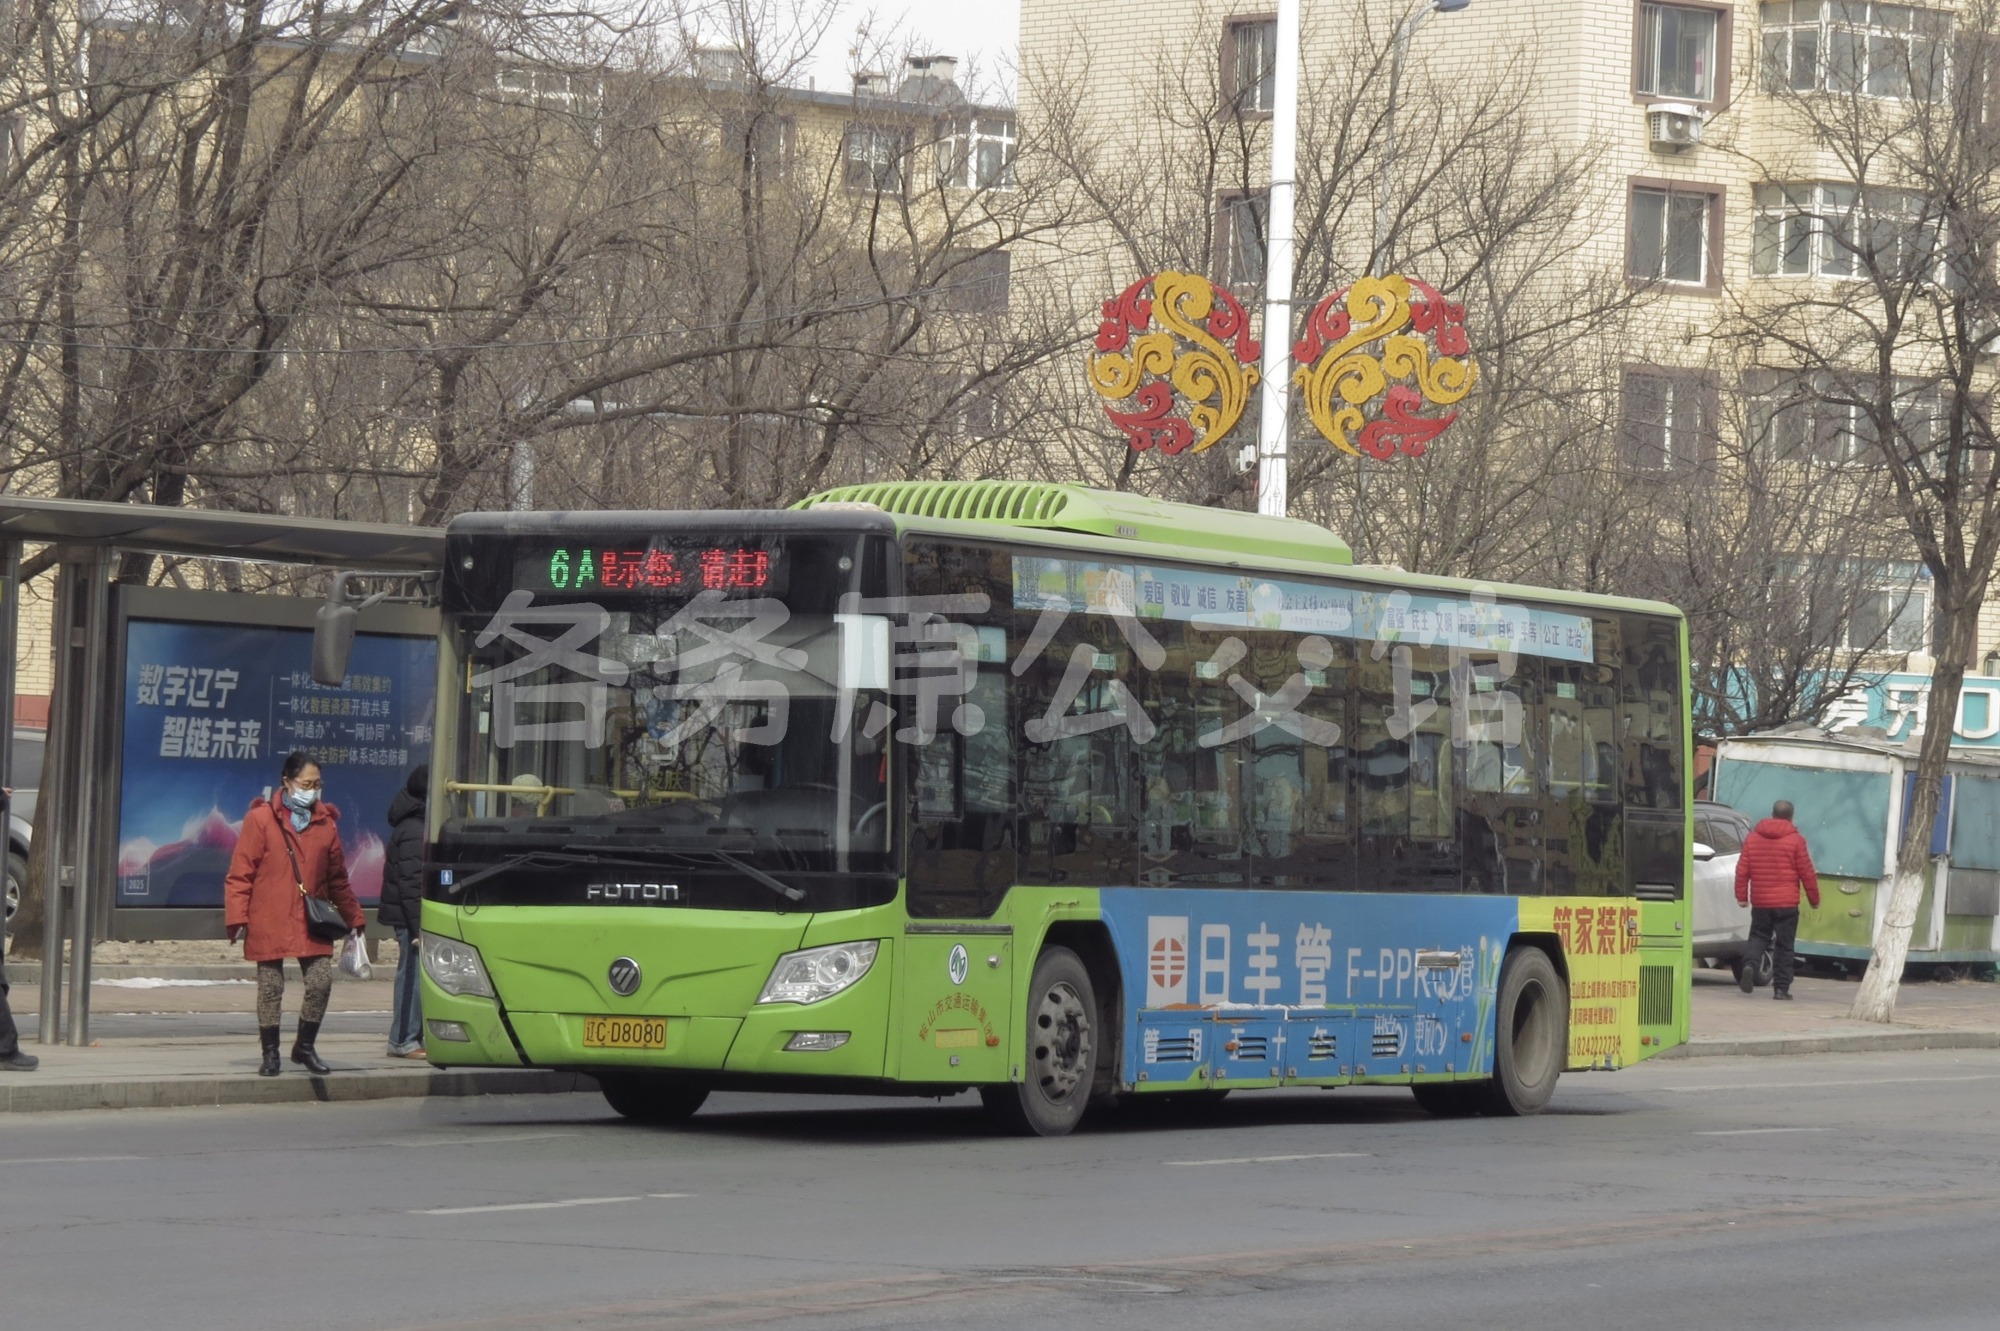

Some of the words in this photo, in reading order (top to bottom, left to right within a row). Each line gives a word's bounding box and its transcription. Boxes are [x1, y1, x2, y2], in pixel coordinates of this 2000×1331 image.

[550, 549, 595, 588] 6A
[1144, 580, 1164, 604] 爱国
[1171, 583, 1191, 607] 敬业
[1197, 586, 1217, 610] 诚信
[1226, 589, 1247, 613] 友善
[1386, 606, 1406, 630] 富强
[1411, 608, 1430, 632] 民主
[1435, 611, 1453, 634] 文明
[1521, 621, 1537, 643] 平等
[1543, 624, 1560, 646] 公正
[1565, 626, 1583, 649] 法治
[136, 664, 240, 709] 数字辽宁
[280, 671, 392, 694] 一体化施高效集约
[279, 696, 391, 718] 一体化数据资源开放共享
[160, 715, 262, 760] 智链未来
[128, 879, 145, 890] 2025
[586, 883, 679, 900] FOTON
[1553, 906, 1638, 955] 筑家装饰
[1200, 921, 1333, 1006] 日丰管
